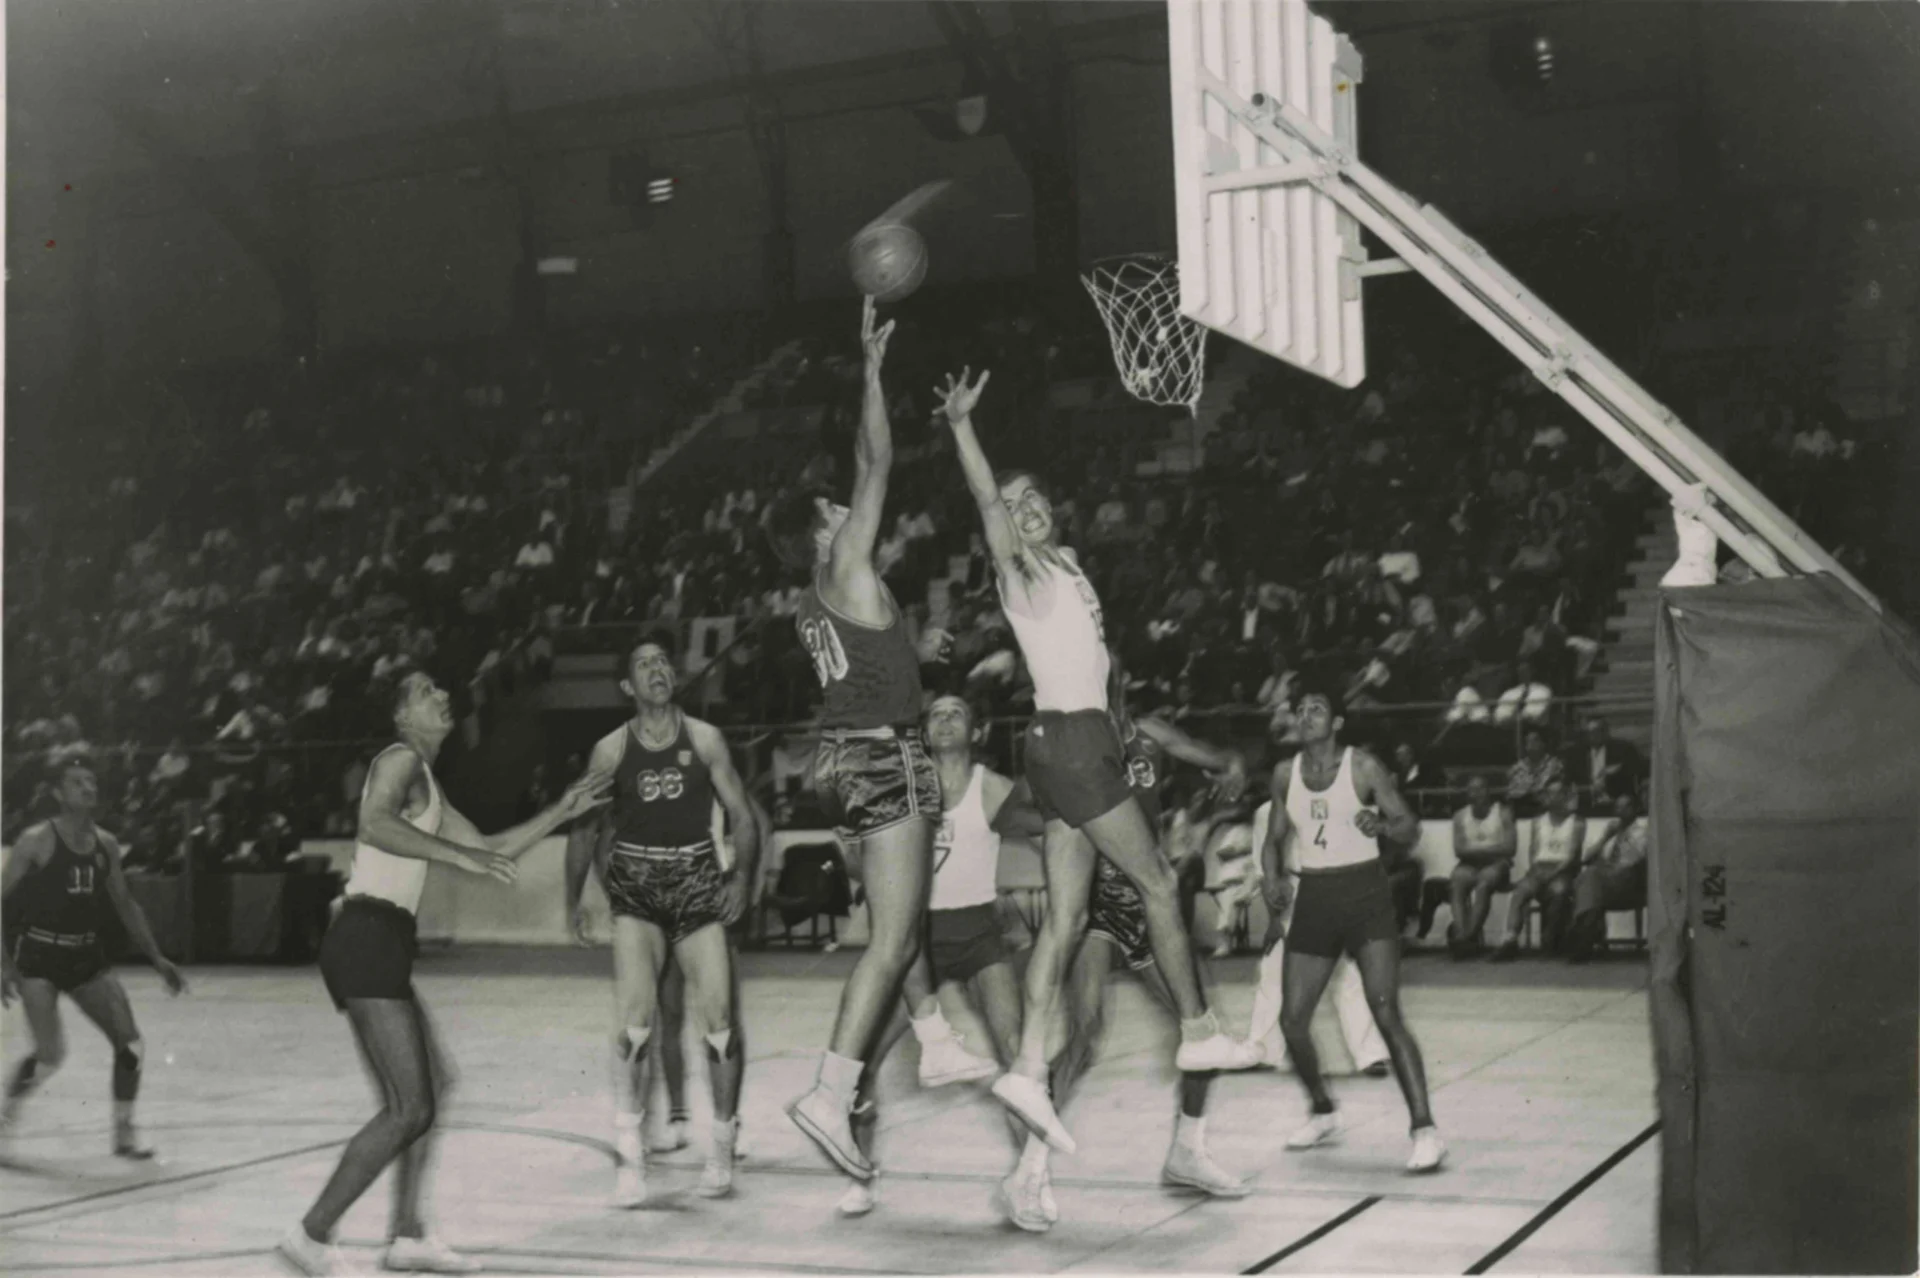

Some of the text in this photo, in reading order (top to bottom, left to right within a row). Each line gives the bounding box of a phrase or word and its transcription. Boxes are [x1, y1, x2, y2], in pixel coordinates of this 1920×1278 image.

[637, 766, 684, 802] 66
[1313, 823, 1328, 850] 4
[934, 845, 951, 875] 7
[67, 864, 94, 894] 11
[1702, 864, 1727, 931] AL-124
